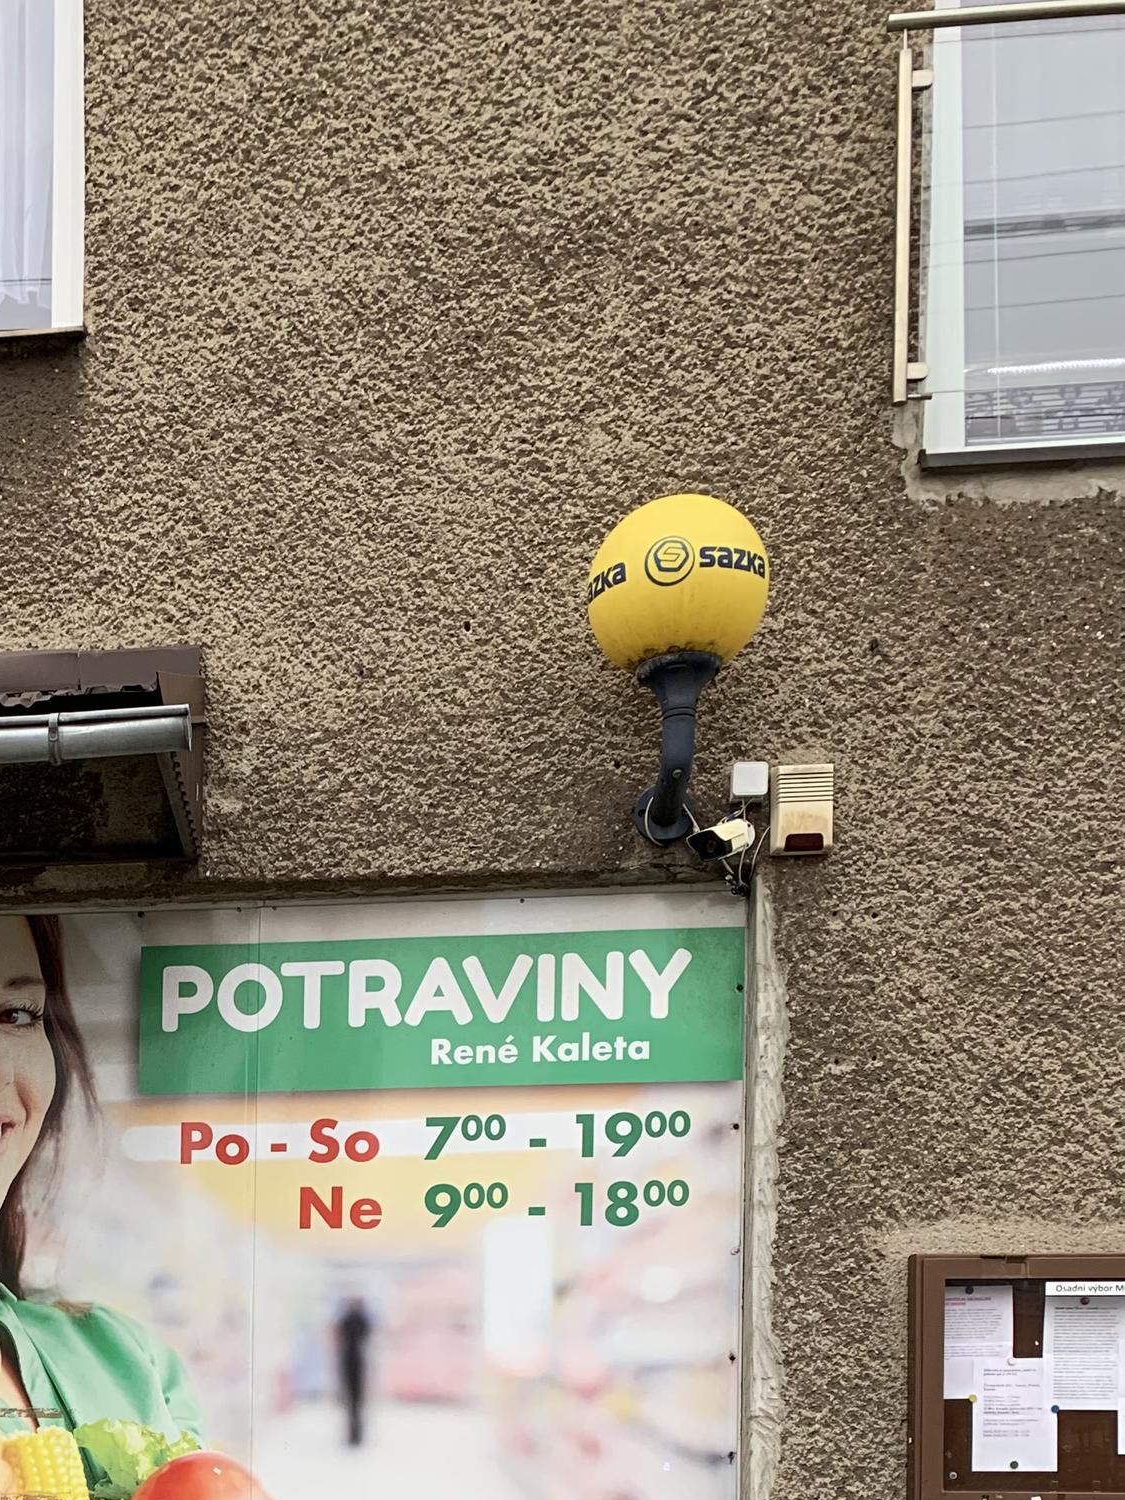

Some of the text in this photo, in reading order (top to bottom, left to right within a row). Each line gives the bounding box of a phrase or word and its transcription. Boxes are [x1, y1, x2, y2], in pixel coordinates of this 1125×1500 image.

[161, 948, 693, 1033] POTRAVINY
[430, 1032, 651, 1066] René Kaleta
[180, 1121, 251, 1166] Po
[308, 1118, 381, 1164] So
[299, 1186, 383, 1230] Ne
[1088, 1285, 1113, 1293] výbor
